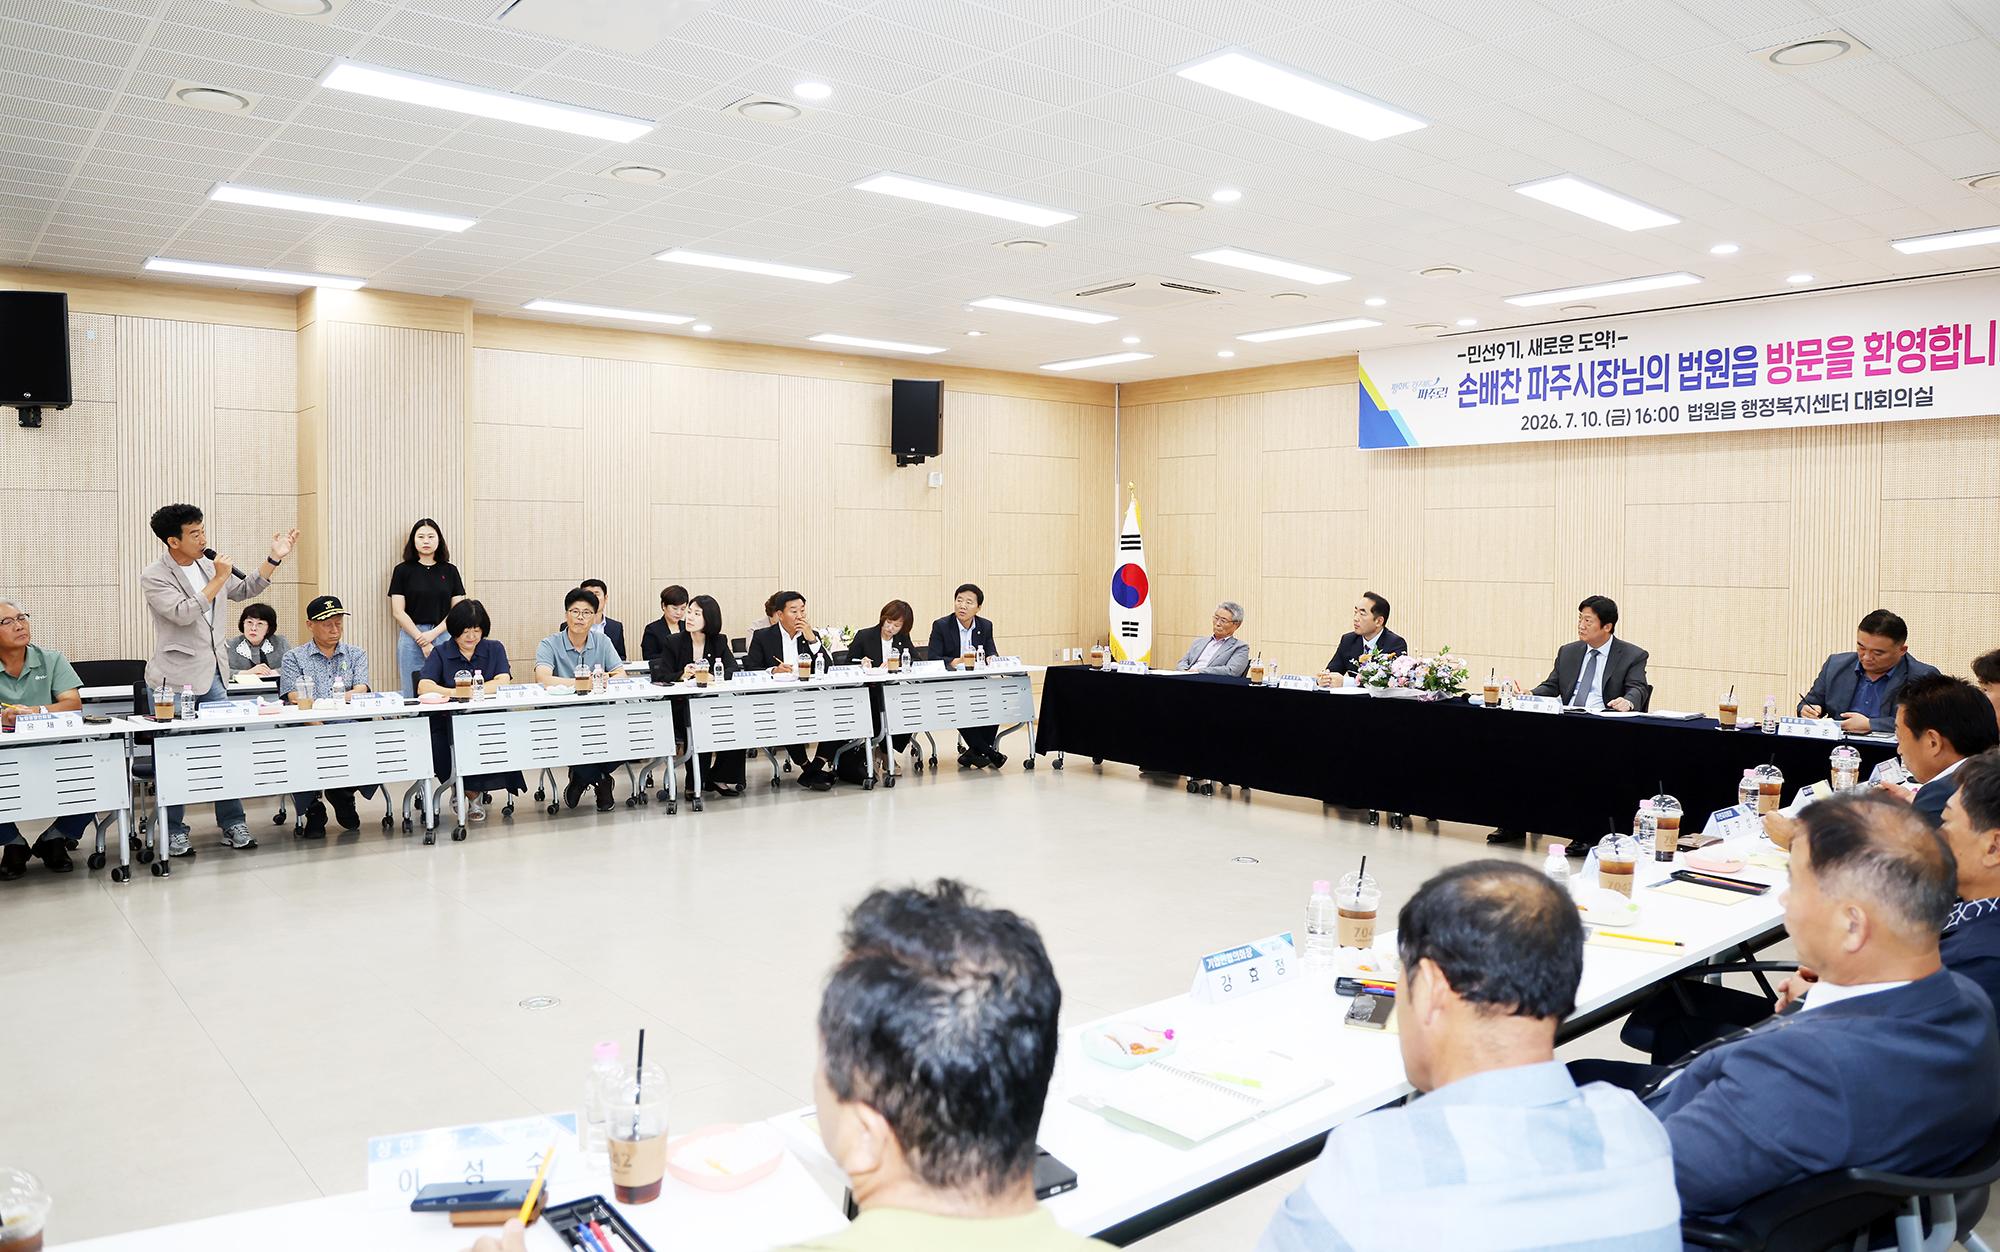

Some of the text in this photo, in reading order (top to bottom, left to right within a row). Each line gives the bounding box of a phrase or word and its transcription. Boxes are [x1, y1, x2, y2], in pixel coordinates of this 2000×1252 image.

[1527, 334, 1575, 357] 새로운
[1458, 319, 2000, 409] 손배찬 파주시장님의 법원읍 방문을 환영합니
[1417, 386, 1449, 400] 파주로!
[1520, 386, 1934, 431] 2026. 7. 10. (금) 16:00 법원읍 행정복지센터 대회의실
